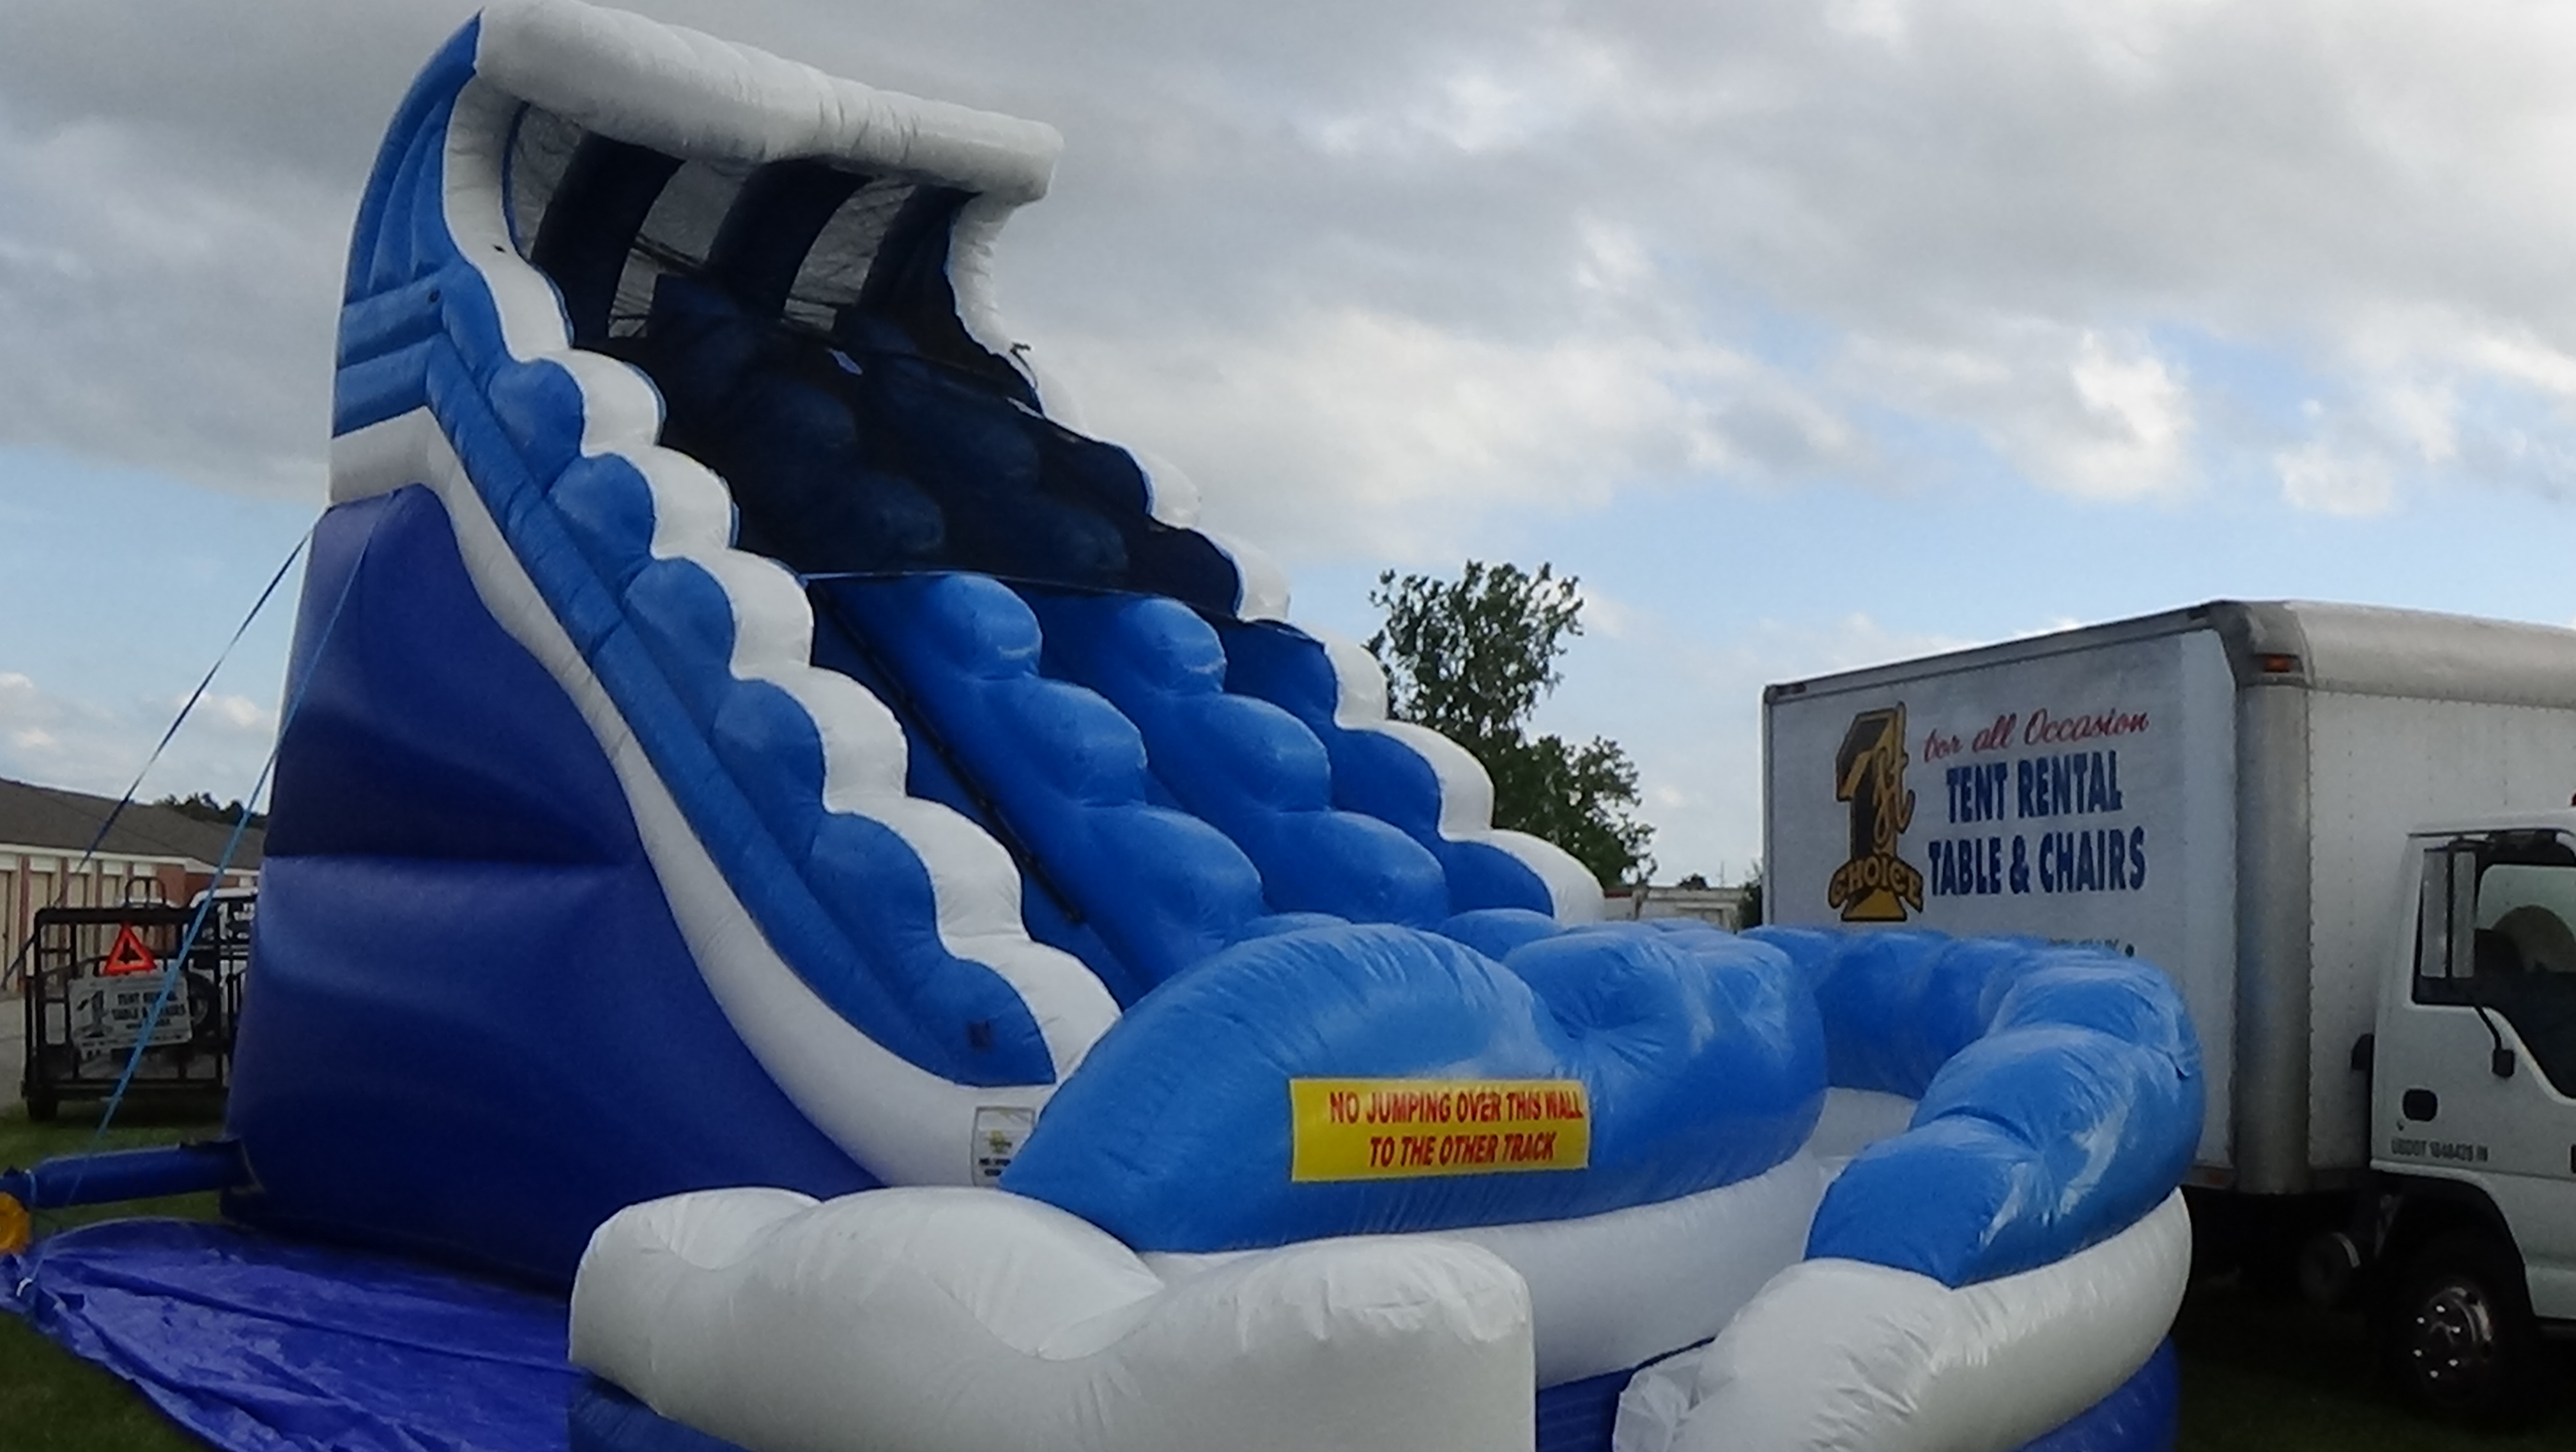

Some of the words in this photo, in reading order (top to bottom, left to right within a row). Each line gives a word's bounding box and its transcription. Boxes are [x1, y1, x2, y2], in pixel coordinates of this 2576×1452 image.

[1971, 713, 2017, 753] all
[2024, 707, 2150, 746] Occasion
[1945, 761, 2008, 824] TENT
[2018, 750, 2122, 818] RENTAL
[1828, 853, 1924, 911] CHOICE
[1928, 837, 2002, 895] TABLE
[2009, 834, 2030, 893] &
[2039, 826, 2145, 893] CHAIRS
[1330, 1091, 1360, 1124] NO
[1367, 1090, 1451, 1124] JUMPING
[1456, 1090, 1501, 1123] OVER
[1506, 1092, 1542, 1121] THIS
[1545, 1090, 1584, 1120] WALL
[1370, 1136, 1397, 1167] TO
[1400, 1136, 1436, 1166] THE
[1439, 1134, 1498, 1166] OTHER
[1504, 1131, 1557, 1162] TRACK
